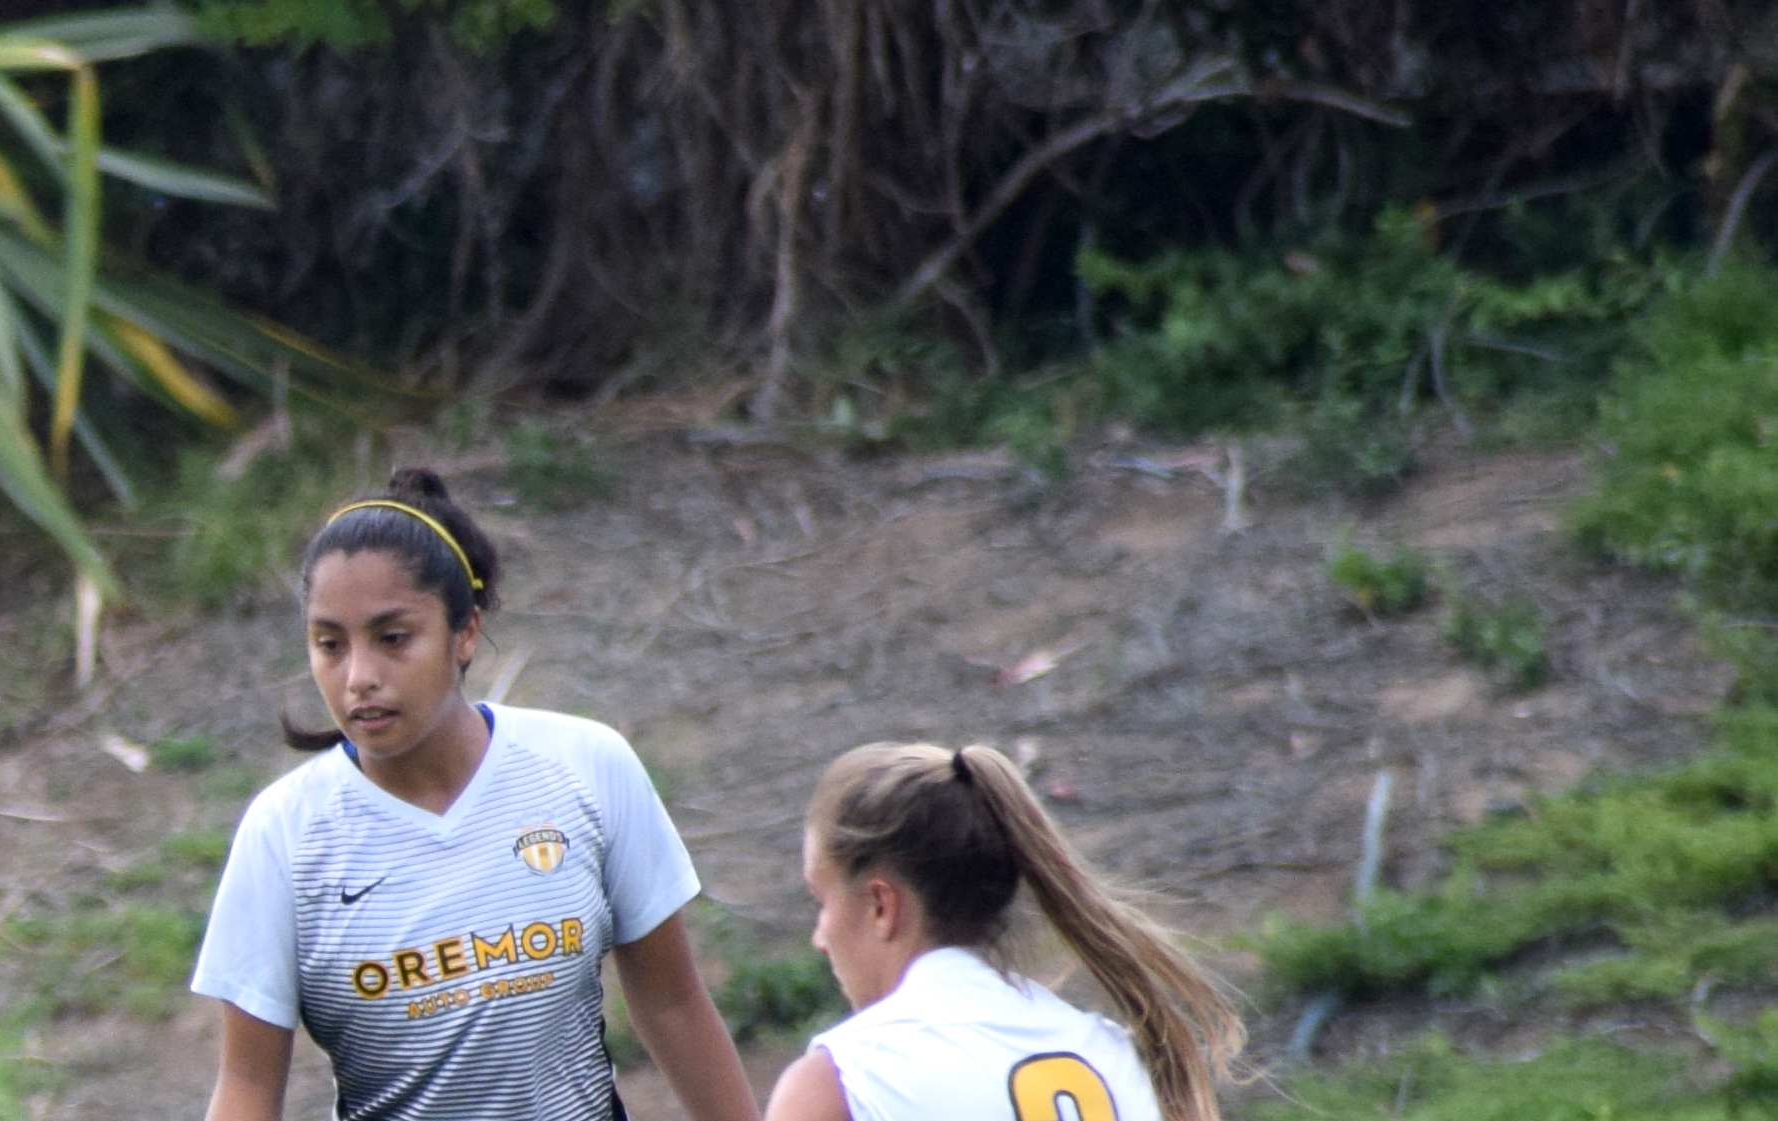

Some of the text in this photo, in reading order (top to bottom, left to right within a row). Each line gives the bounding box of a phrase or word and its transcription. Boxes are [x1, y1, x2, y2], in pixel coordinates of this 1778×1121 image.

[352, 917, 584, 1000] OREMOR
[408, 972, 555, 1019] AUTO GROUP
